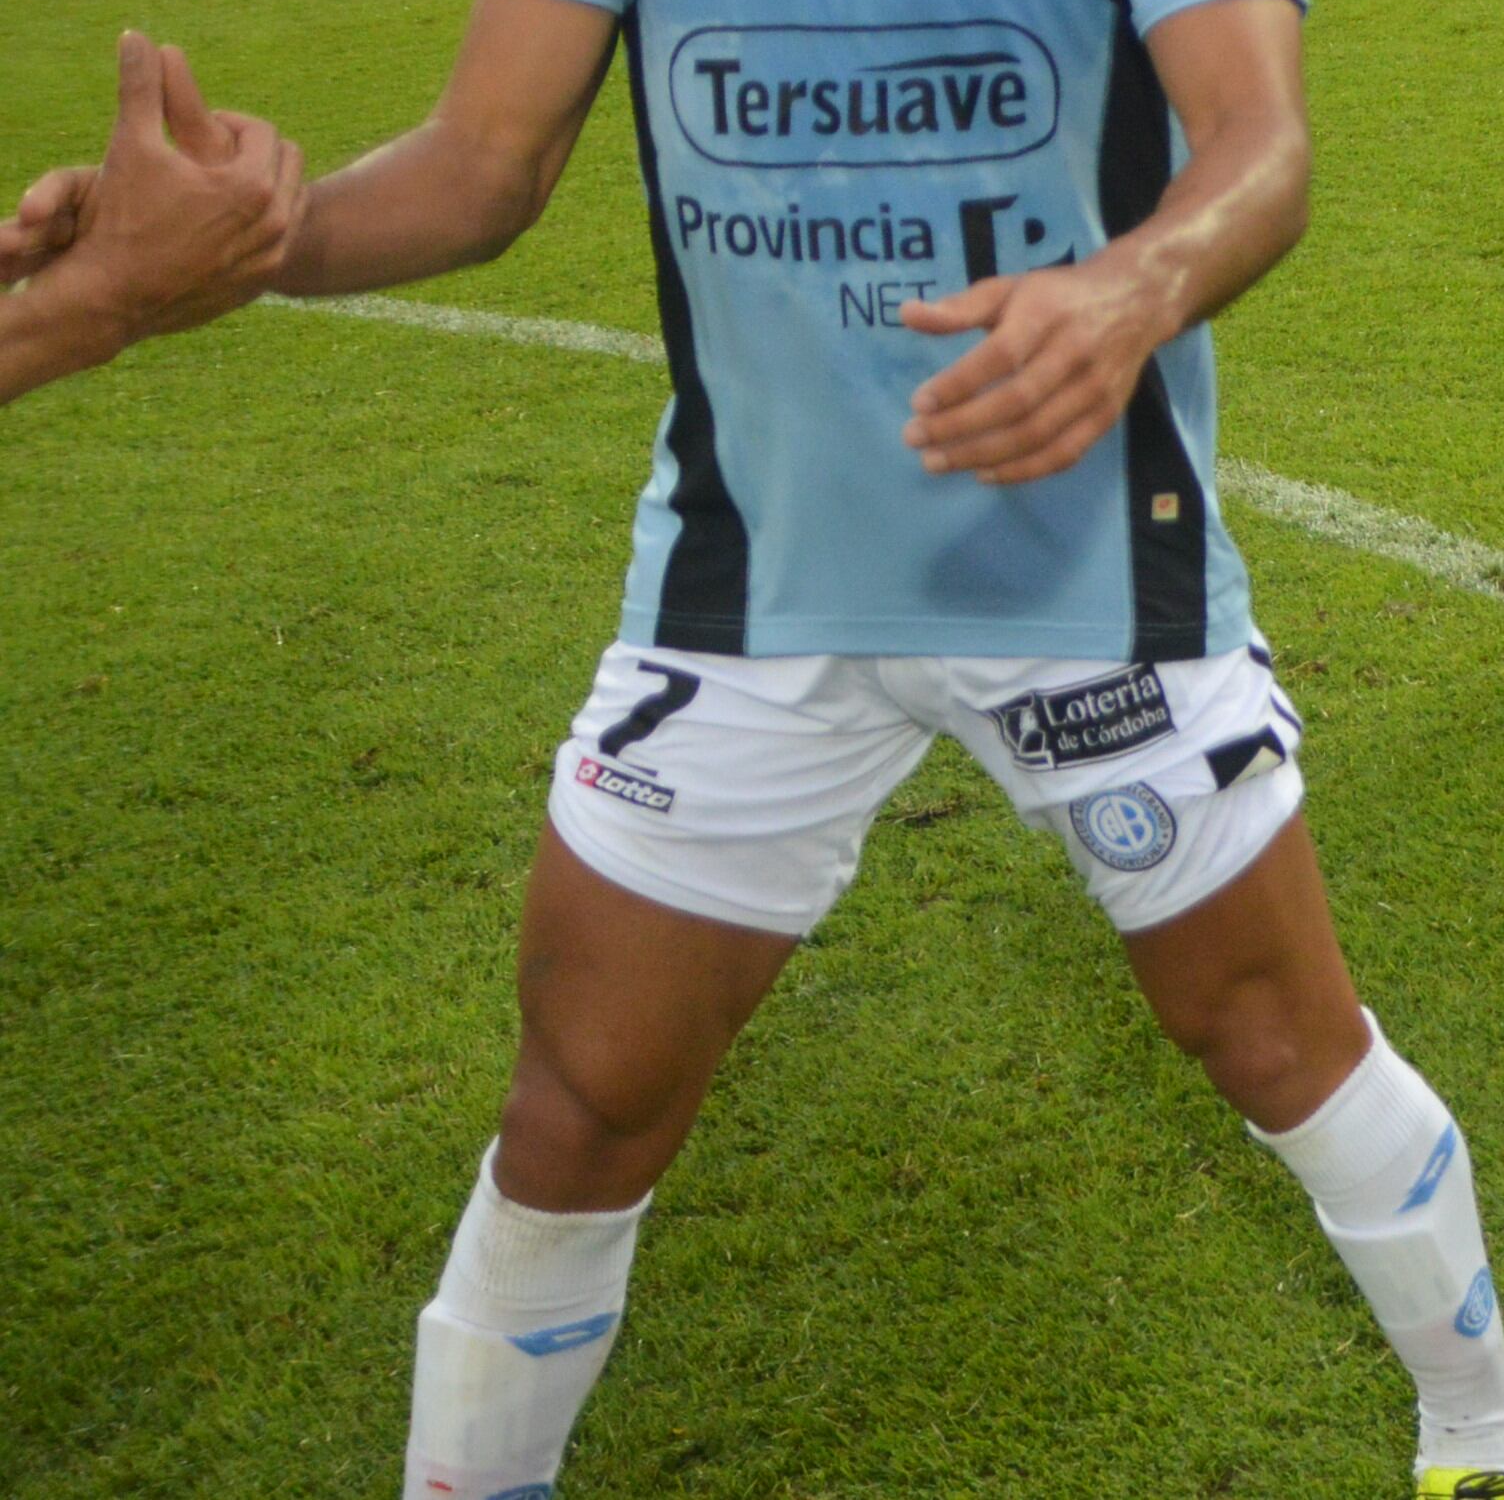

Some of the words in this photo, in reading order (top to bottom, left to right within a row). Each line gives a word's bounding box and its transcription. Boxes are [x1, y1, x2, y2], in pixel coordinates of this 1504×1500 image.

[693, 57, 1027, 137] Tersuave
[675, 195, 935, 263] Provincia
[598, 659, 702, 760] 7
[1043, 671, 1162, 727] Lotería
[1057, 731, 1080, 751] de
[1082, 704, 1168, 747] Córdoba
[596, 769, 673, 809] lotto
